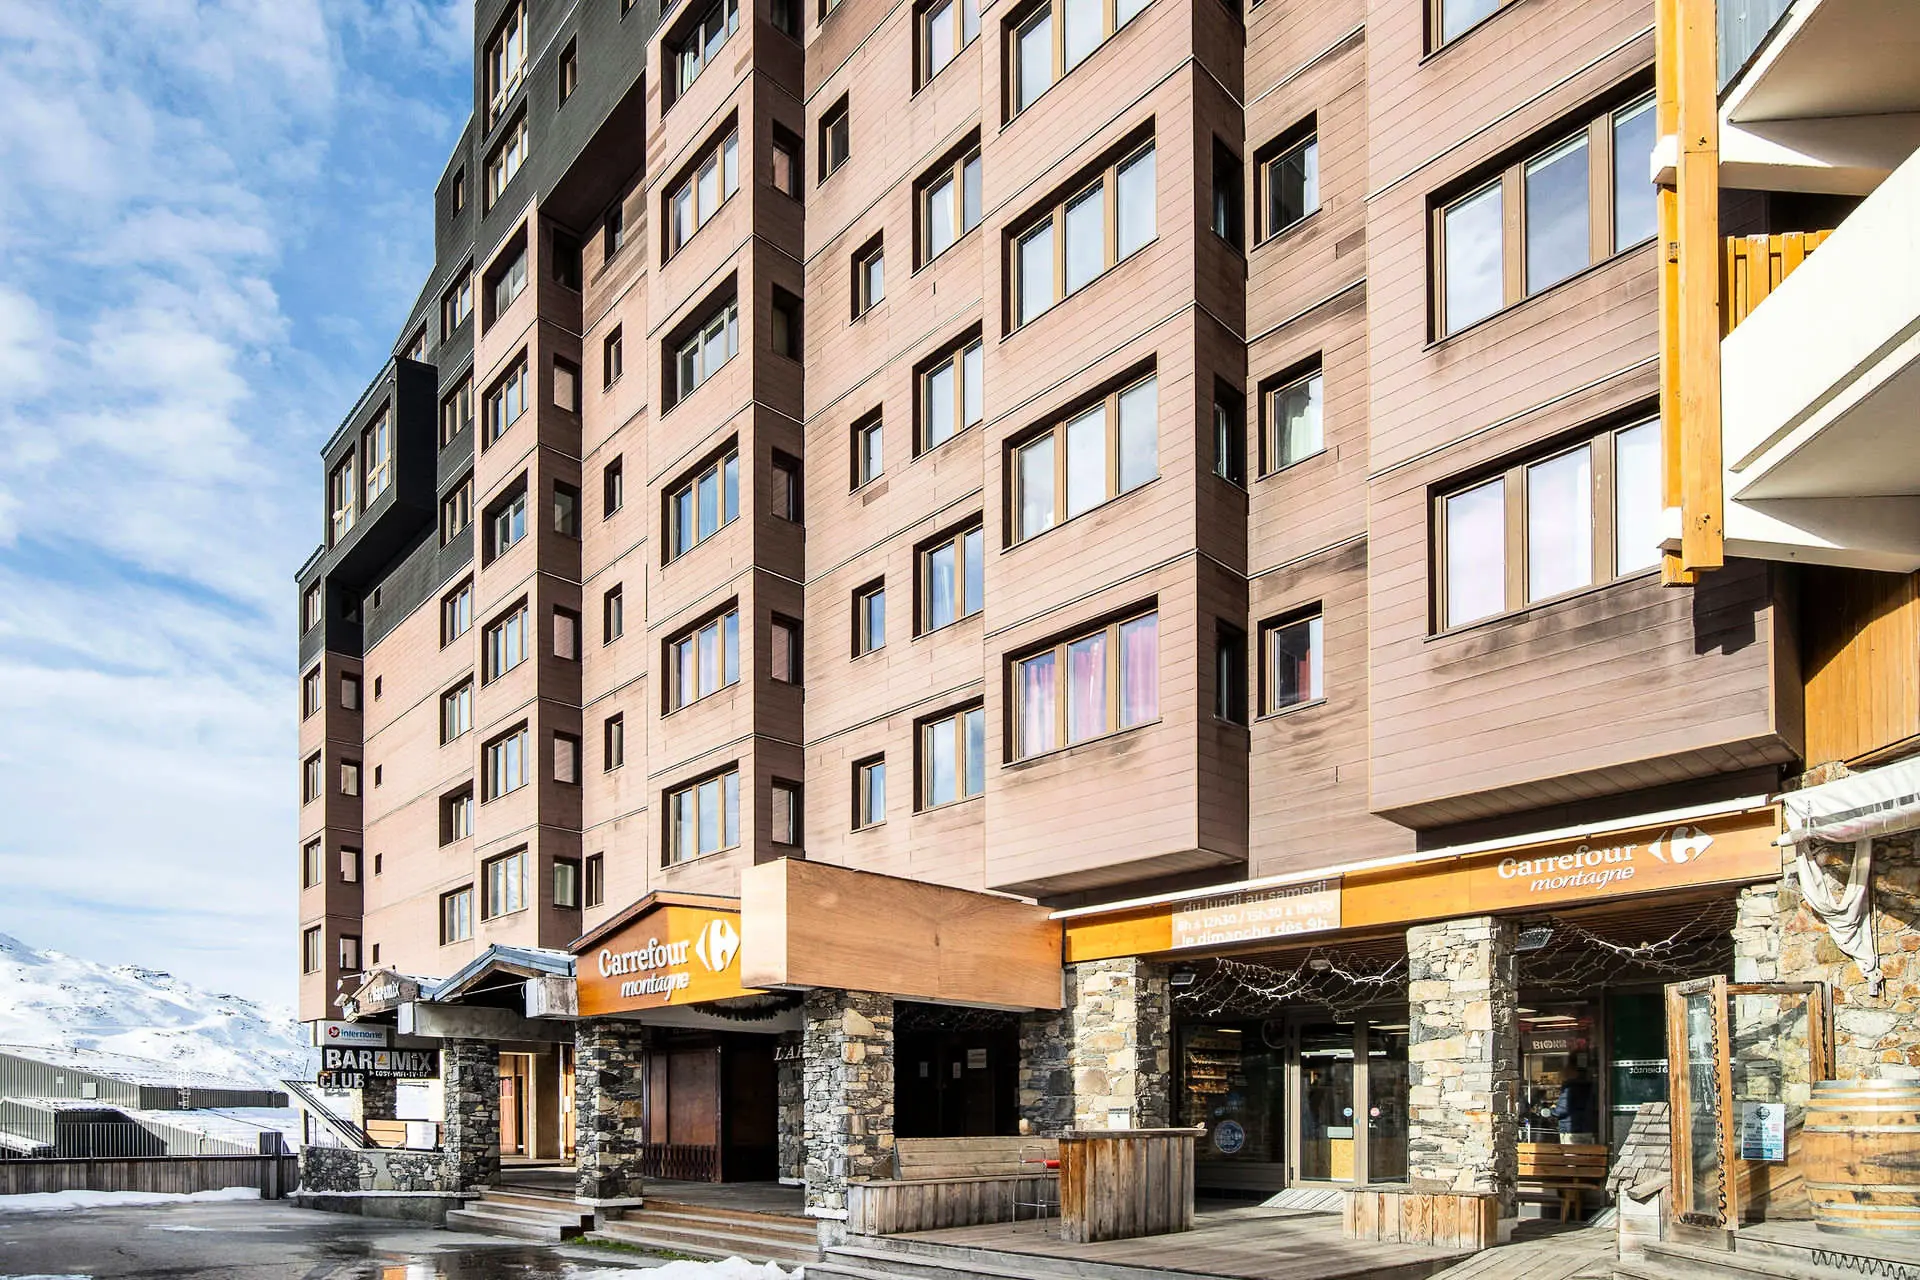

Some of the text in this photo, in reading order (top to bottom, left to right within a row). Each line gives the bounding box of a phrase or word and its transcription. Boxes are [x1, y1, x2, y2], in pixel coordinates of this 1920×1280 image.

[1497, 843, 1638, 879] Carrefour
[1530, 865, 1635, 892] montagne
[1183, 880, 1328, 913] du lundi au samedi
[1182, 932, 1195, 946] le
[1197, 923, 1271, 944] dimanche
[598, 937, 691, 978] Carrefour
[620, 971, 690, 1001] montagne
[319, 1072, 365, 1089] CLUB
